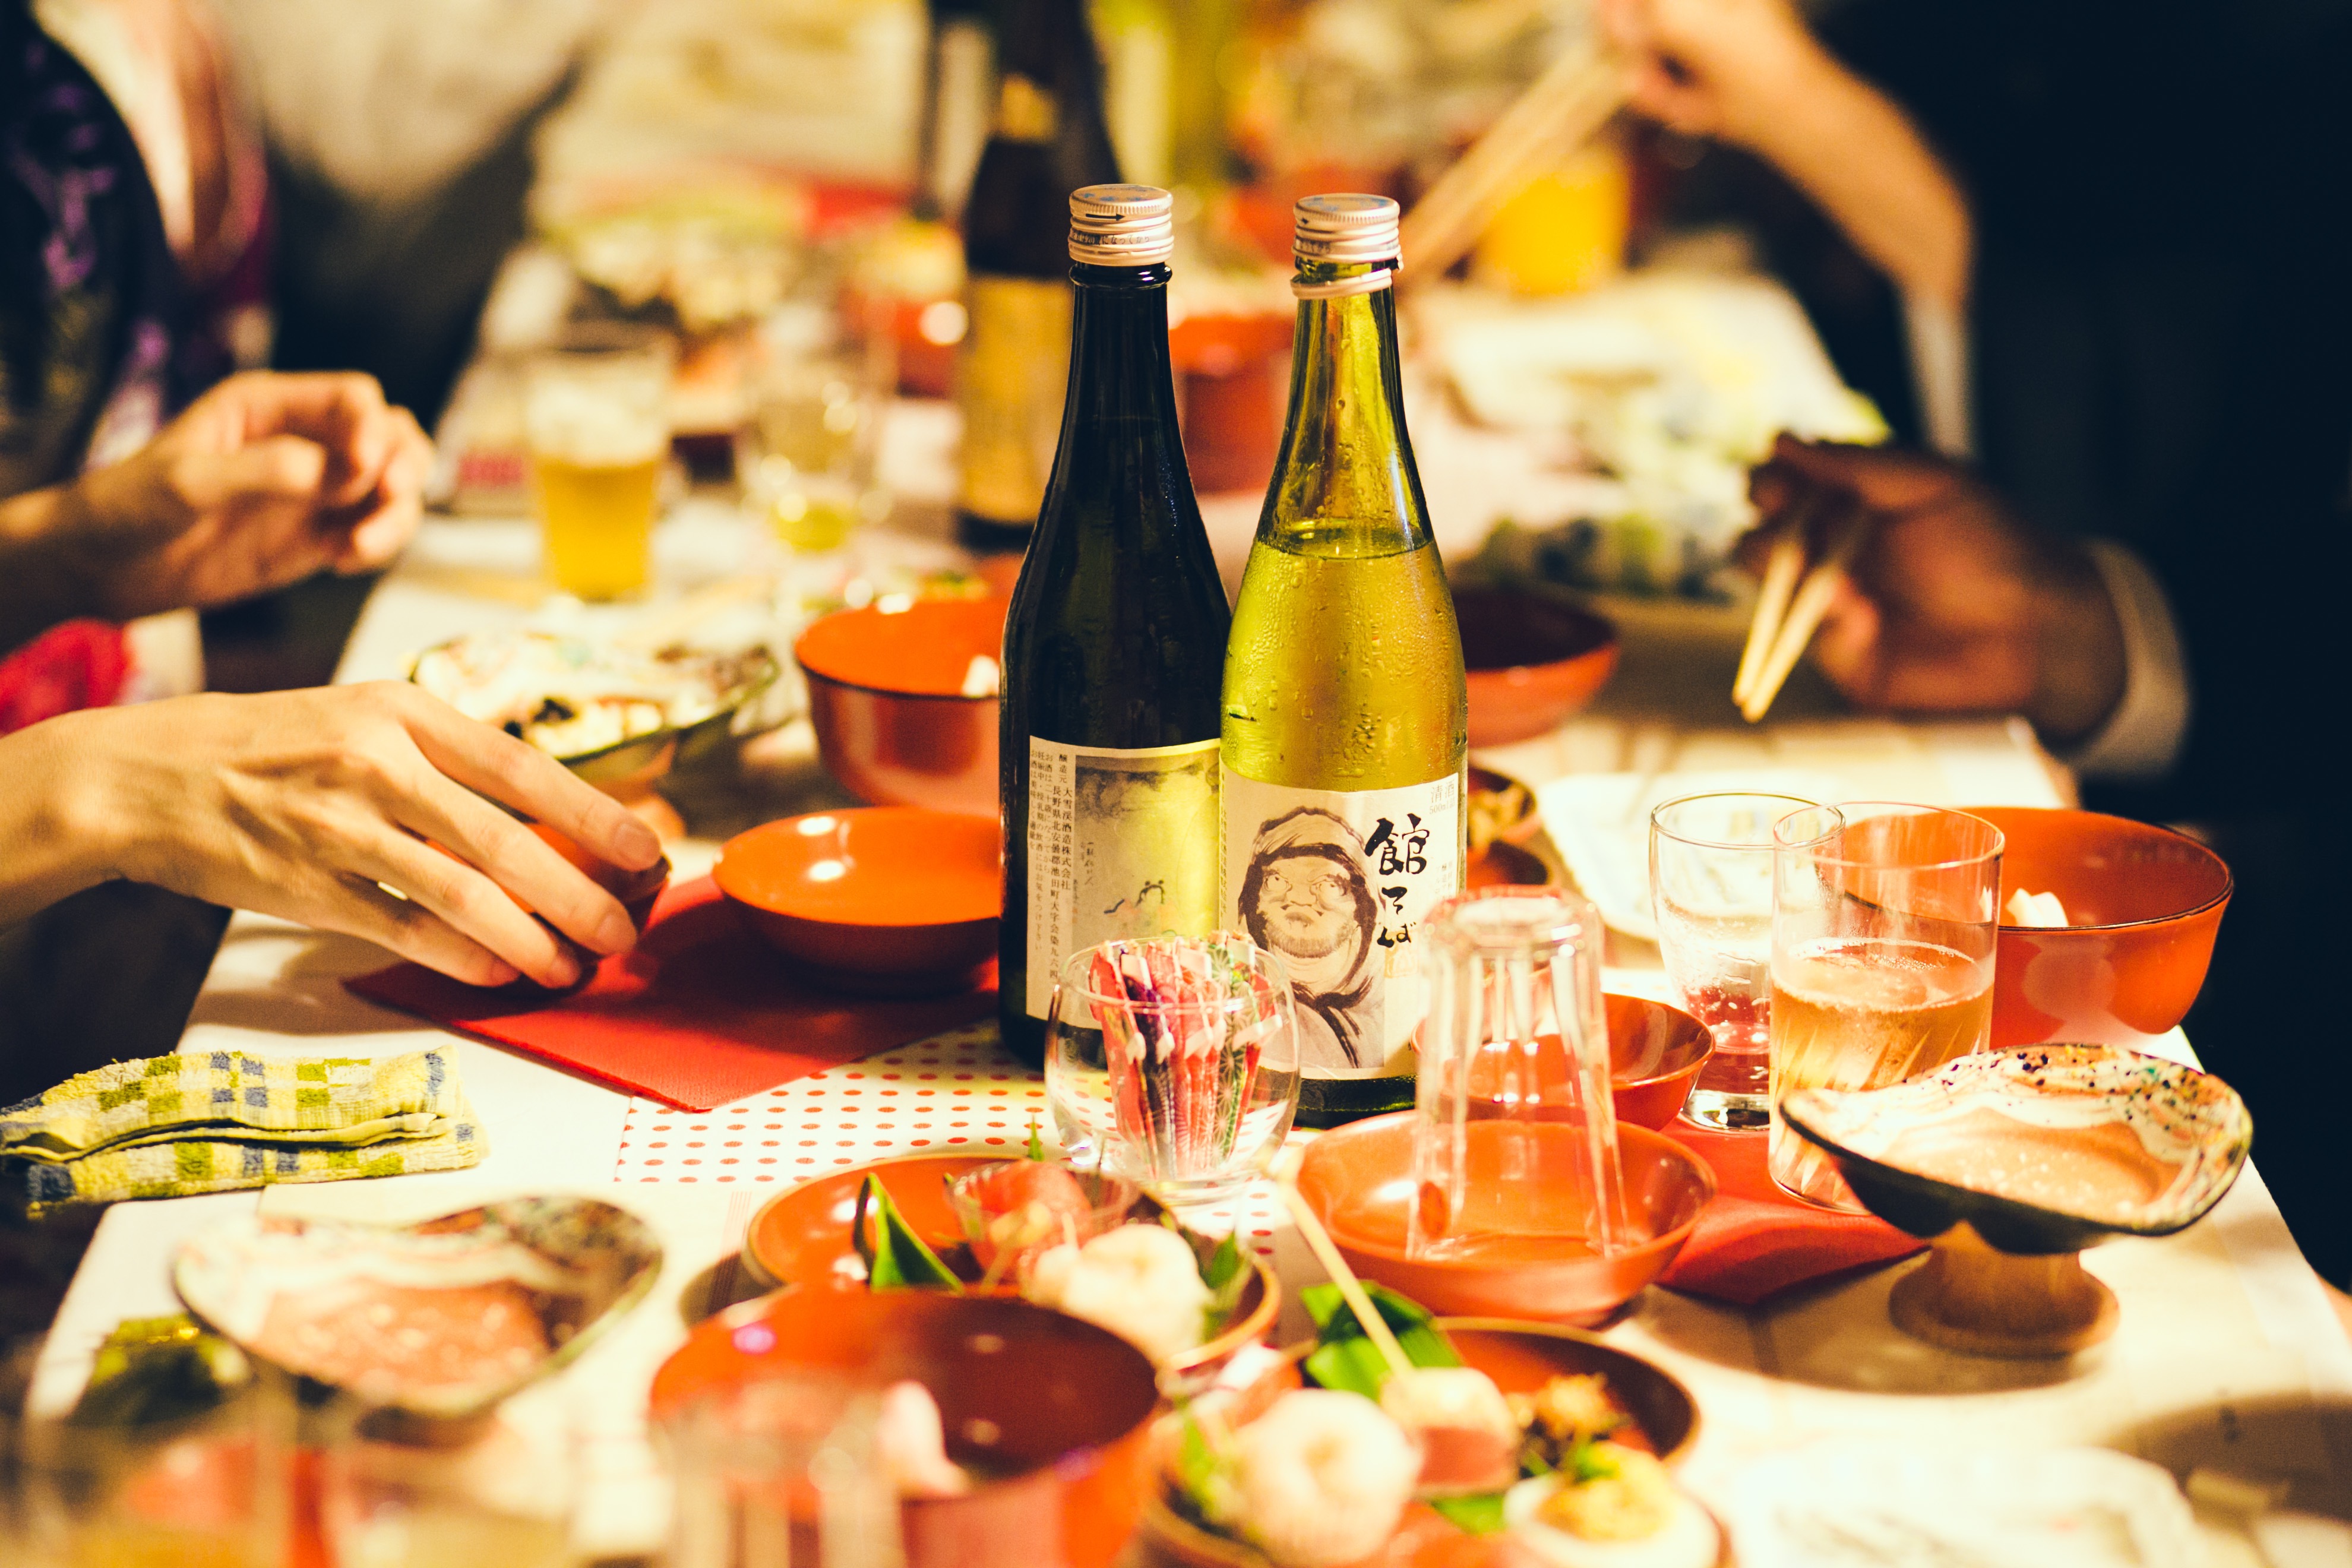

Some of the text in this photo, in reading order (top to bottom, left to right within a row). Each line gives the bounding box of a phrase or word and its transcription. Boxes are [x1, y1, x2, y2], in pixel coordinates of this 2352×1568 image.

[1058, 753, 1068, 784] 醸造元
[1430, 779, 1455, 804] 清酒
